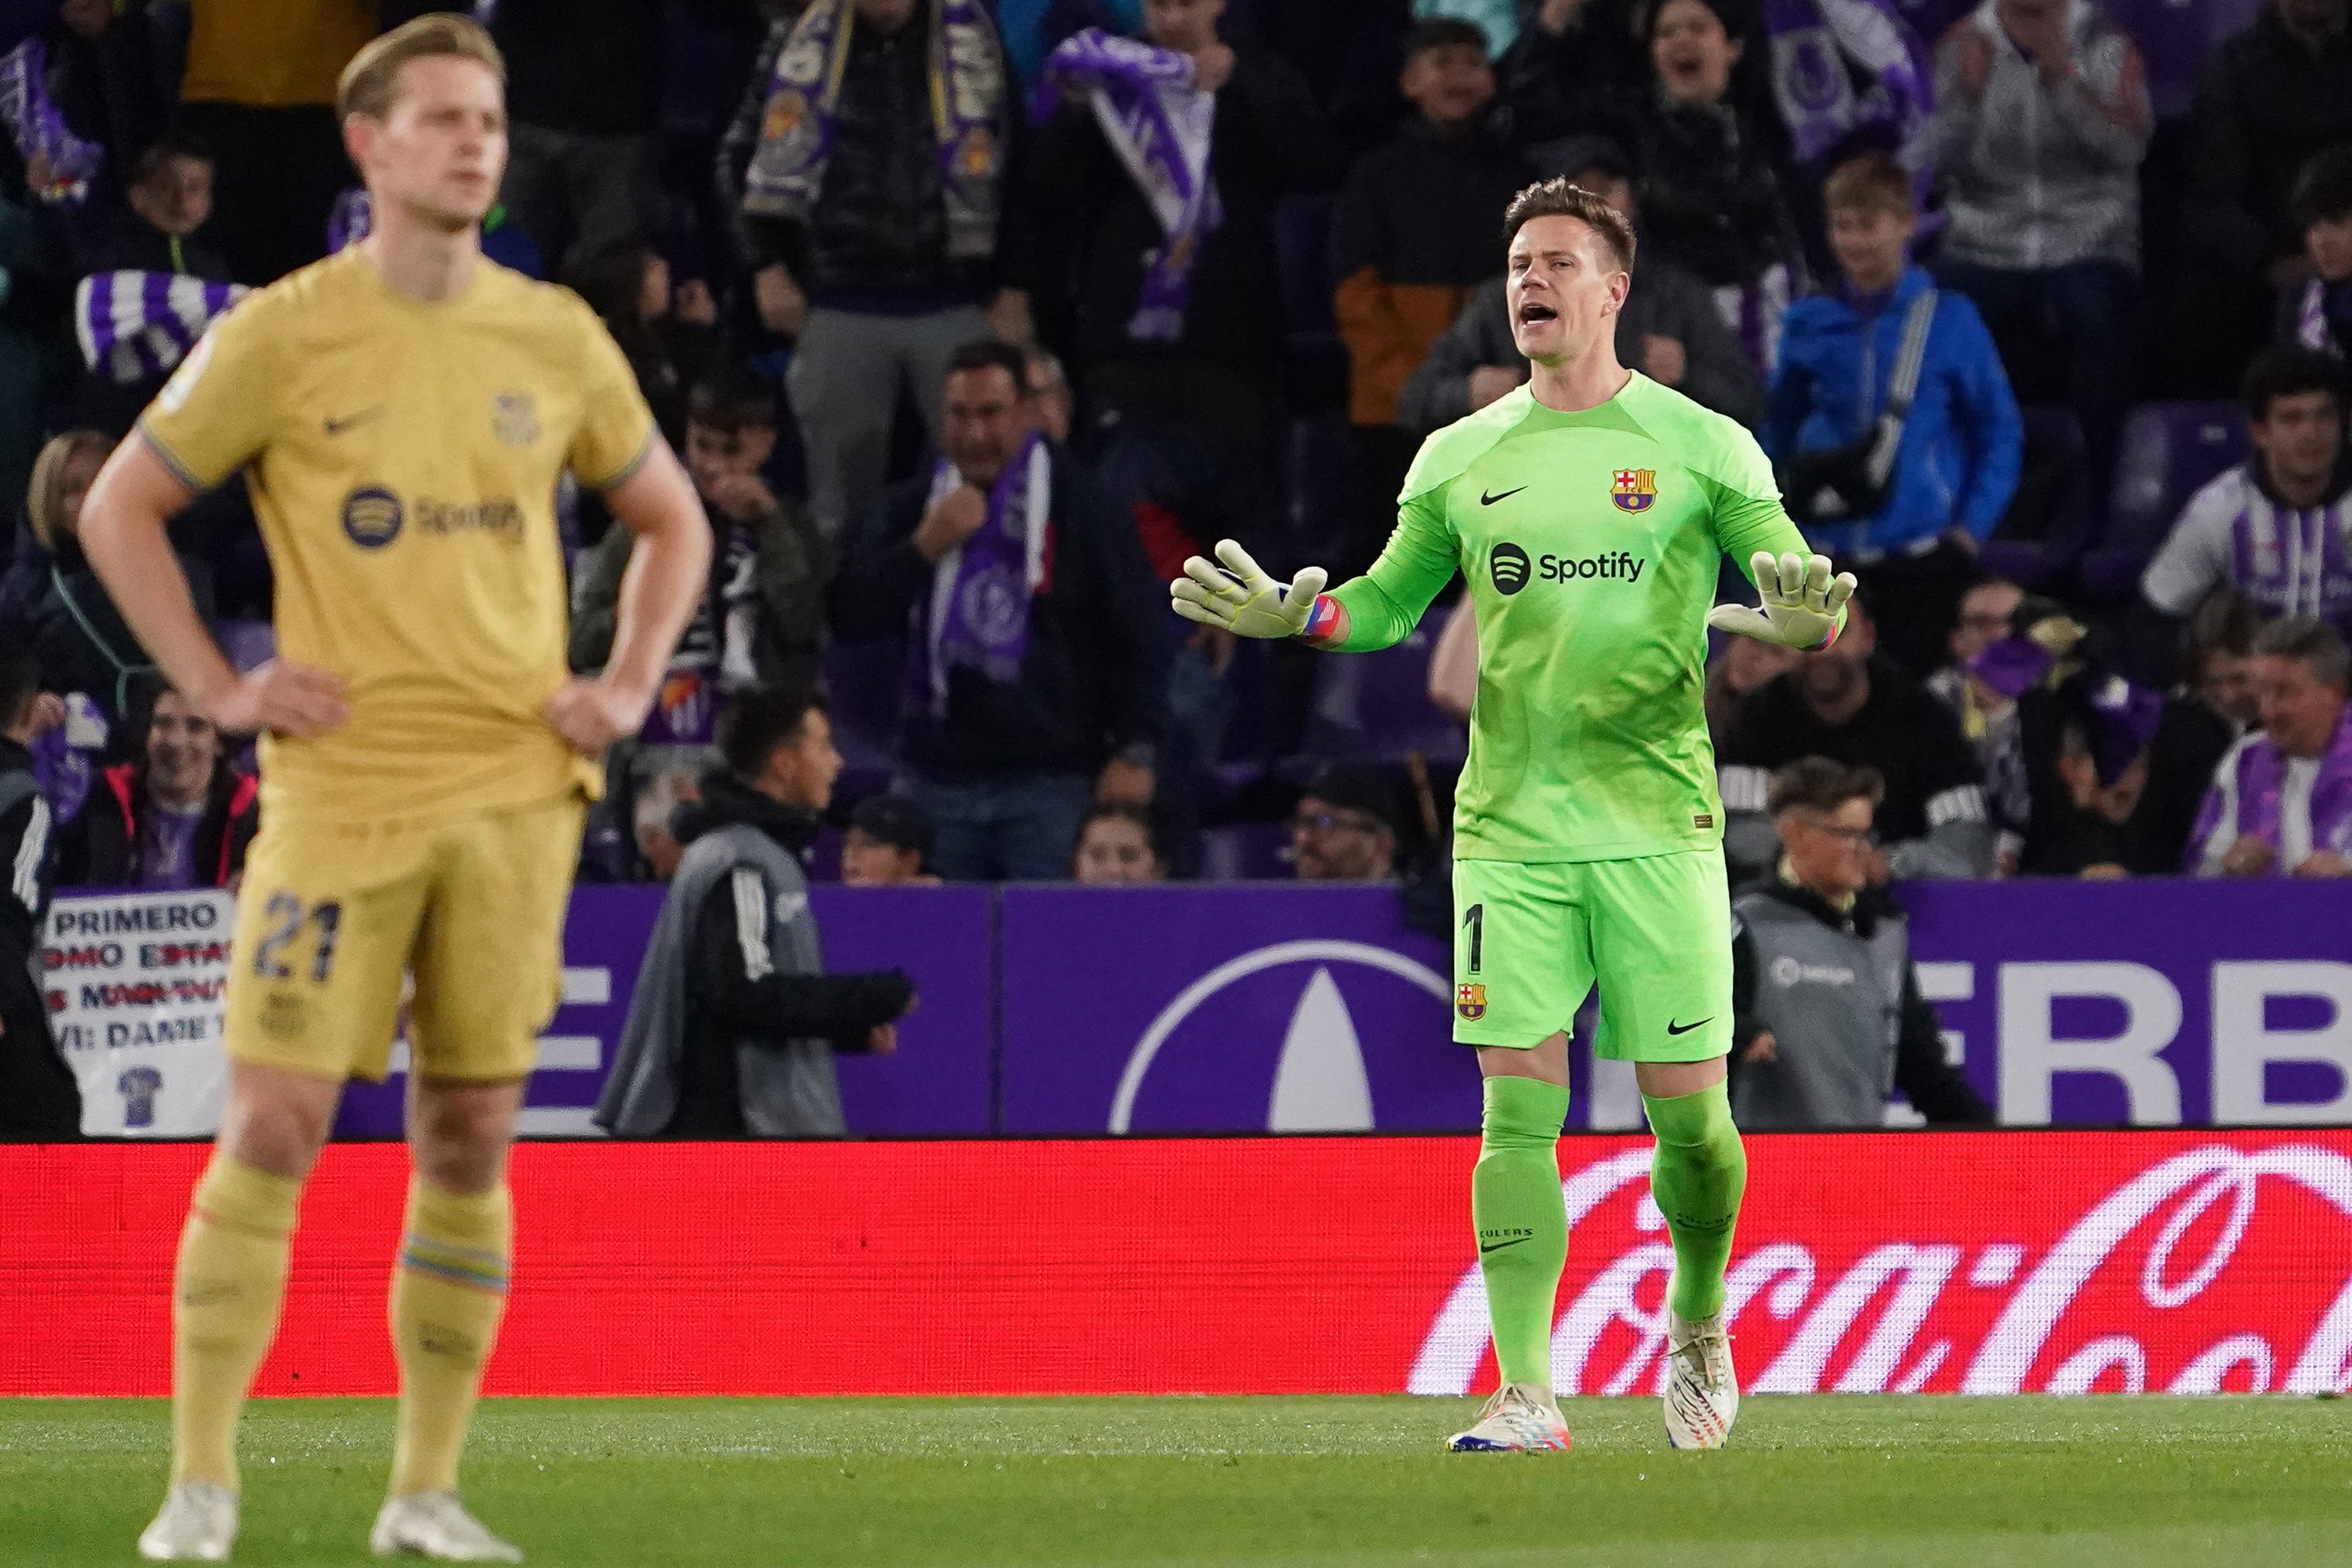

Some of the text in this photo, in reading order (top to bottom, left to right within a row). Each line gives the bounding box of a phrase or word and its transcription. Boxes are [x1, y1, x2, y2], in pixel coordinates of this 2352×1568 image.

[1539, 551, 1644, 584] Spotify
[55, 904, 216, 938] PRIMERO
[253, 890, 341, 984] 21
[139, 939, 231, 968] ESTA
[1462, 904, 1483, 975] 1
[107, 1016, 205, 1049] DAME
[1479, 1228, 1533, 1238] CULERS
